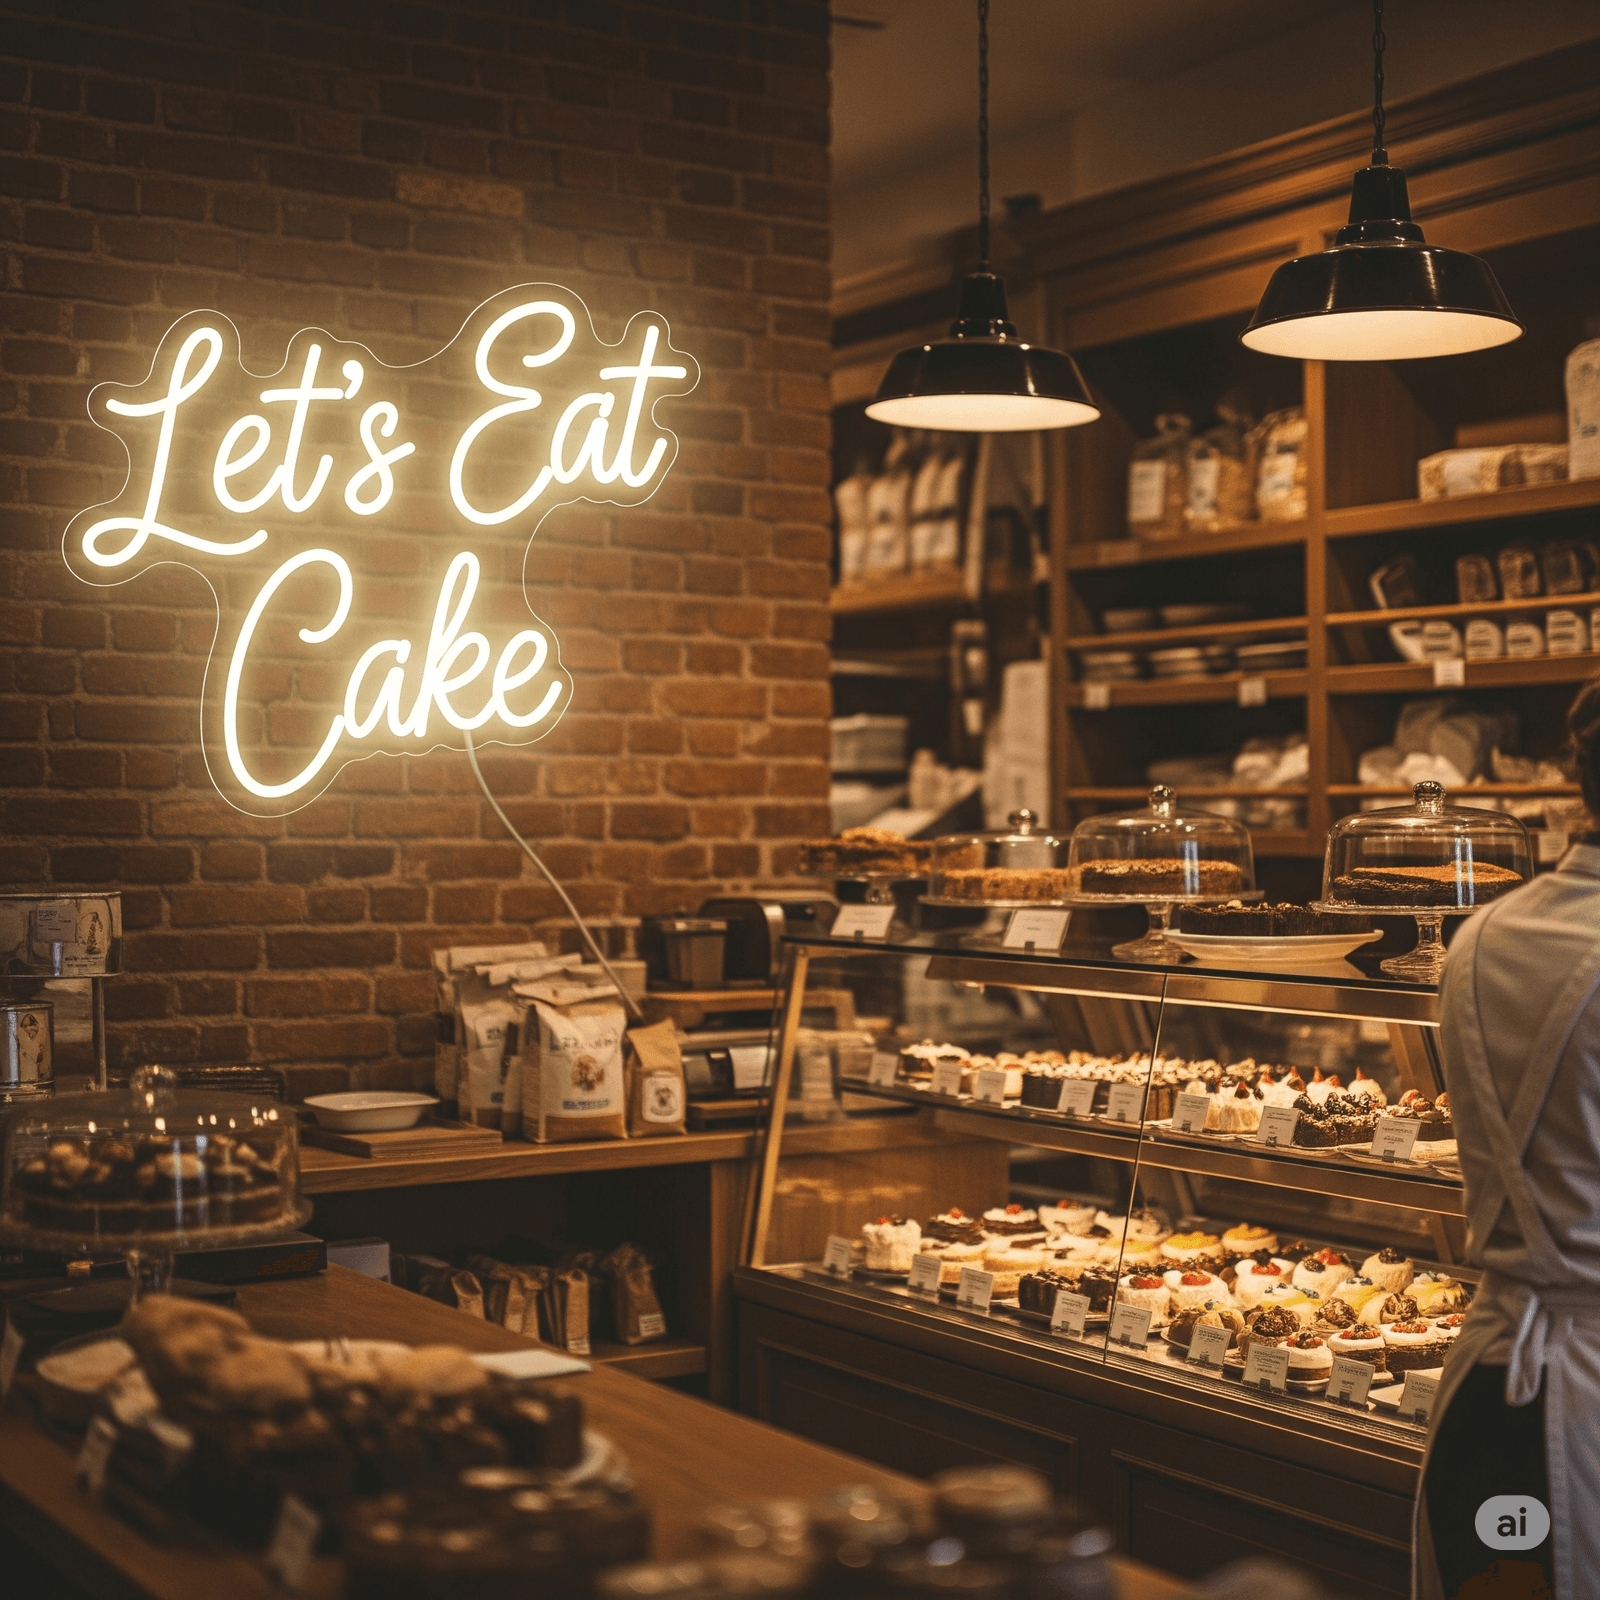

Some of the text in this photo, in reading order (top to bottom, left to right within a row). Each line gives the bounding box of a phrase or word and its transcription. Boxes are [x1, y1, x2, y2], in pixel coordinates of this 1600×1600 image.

[82, 300, 688, 567] Let's Eat
[223, 548, 563, 799] Cake
